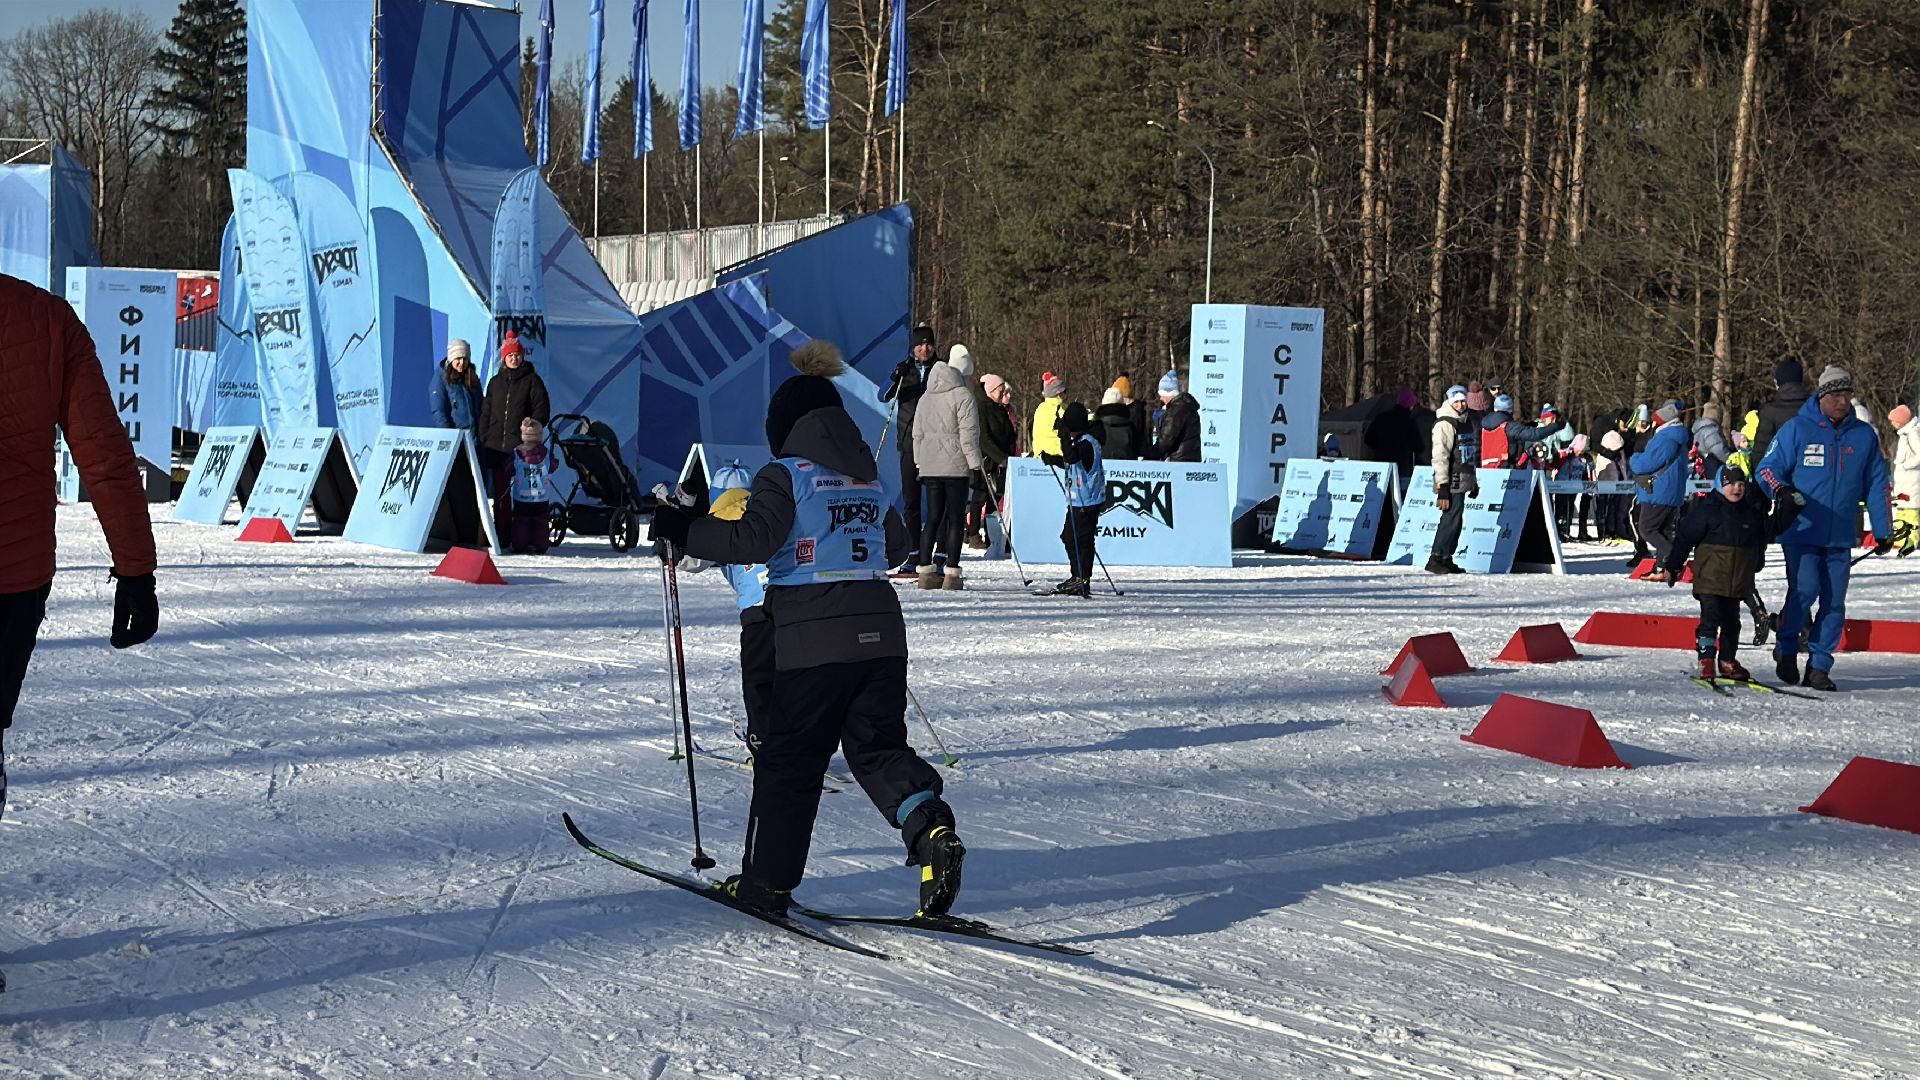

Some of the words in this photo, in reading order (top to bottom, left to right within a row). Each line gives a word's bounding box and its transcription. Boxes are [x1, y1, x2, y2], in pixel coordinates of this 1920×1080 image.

[1269, 344, 1292, 484] СТАРТ
[1109, 470, 1171, 480] PANZHINSKIY
[528, 480, 538, 489] 16
[381, 501, 402, 515] FAMILY
[843, 526, 869, 535] FAMILY
[1095, 527, 1147, 538] FAMILY
[851, 538, 869, 562] 5
